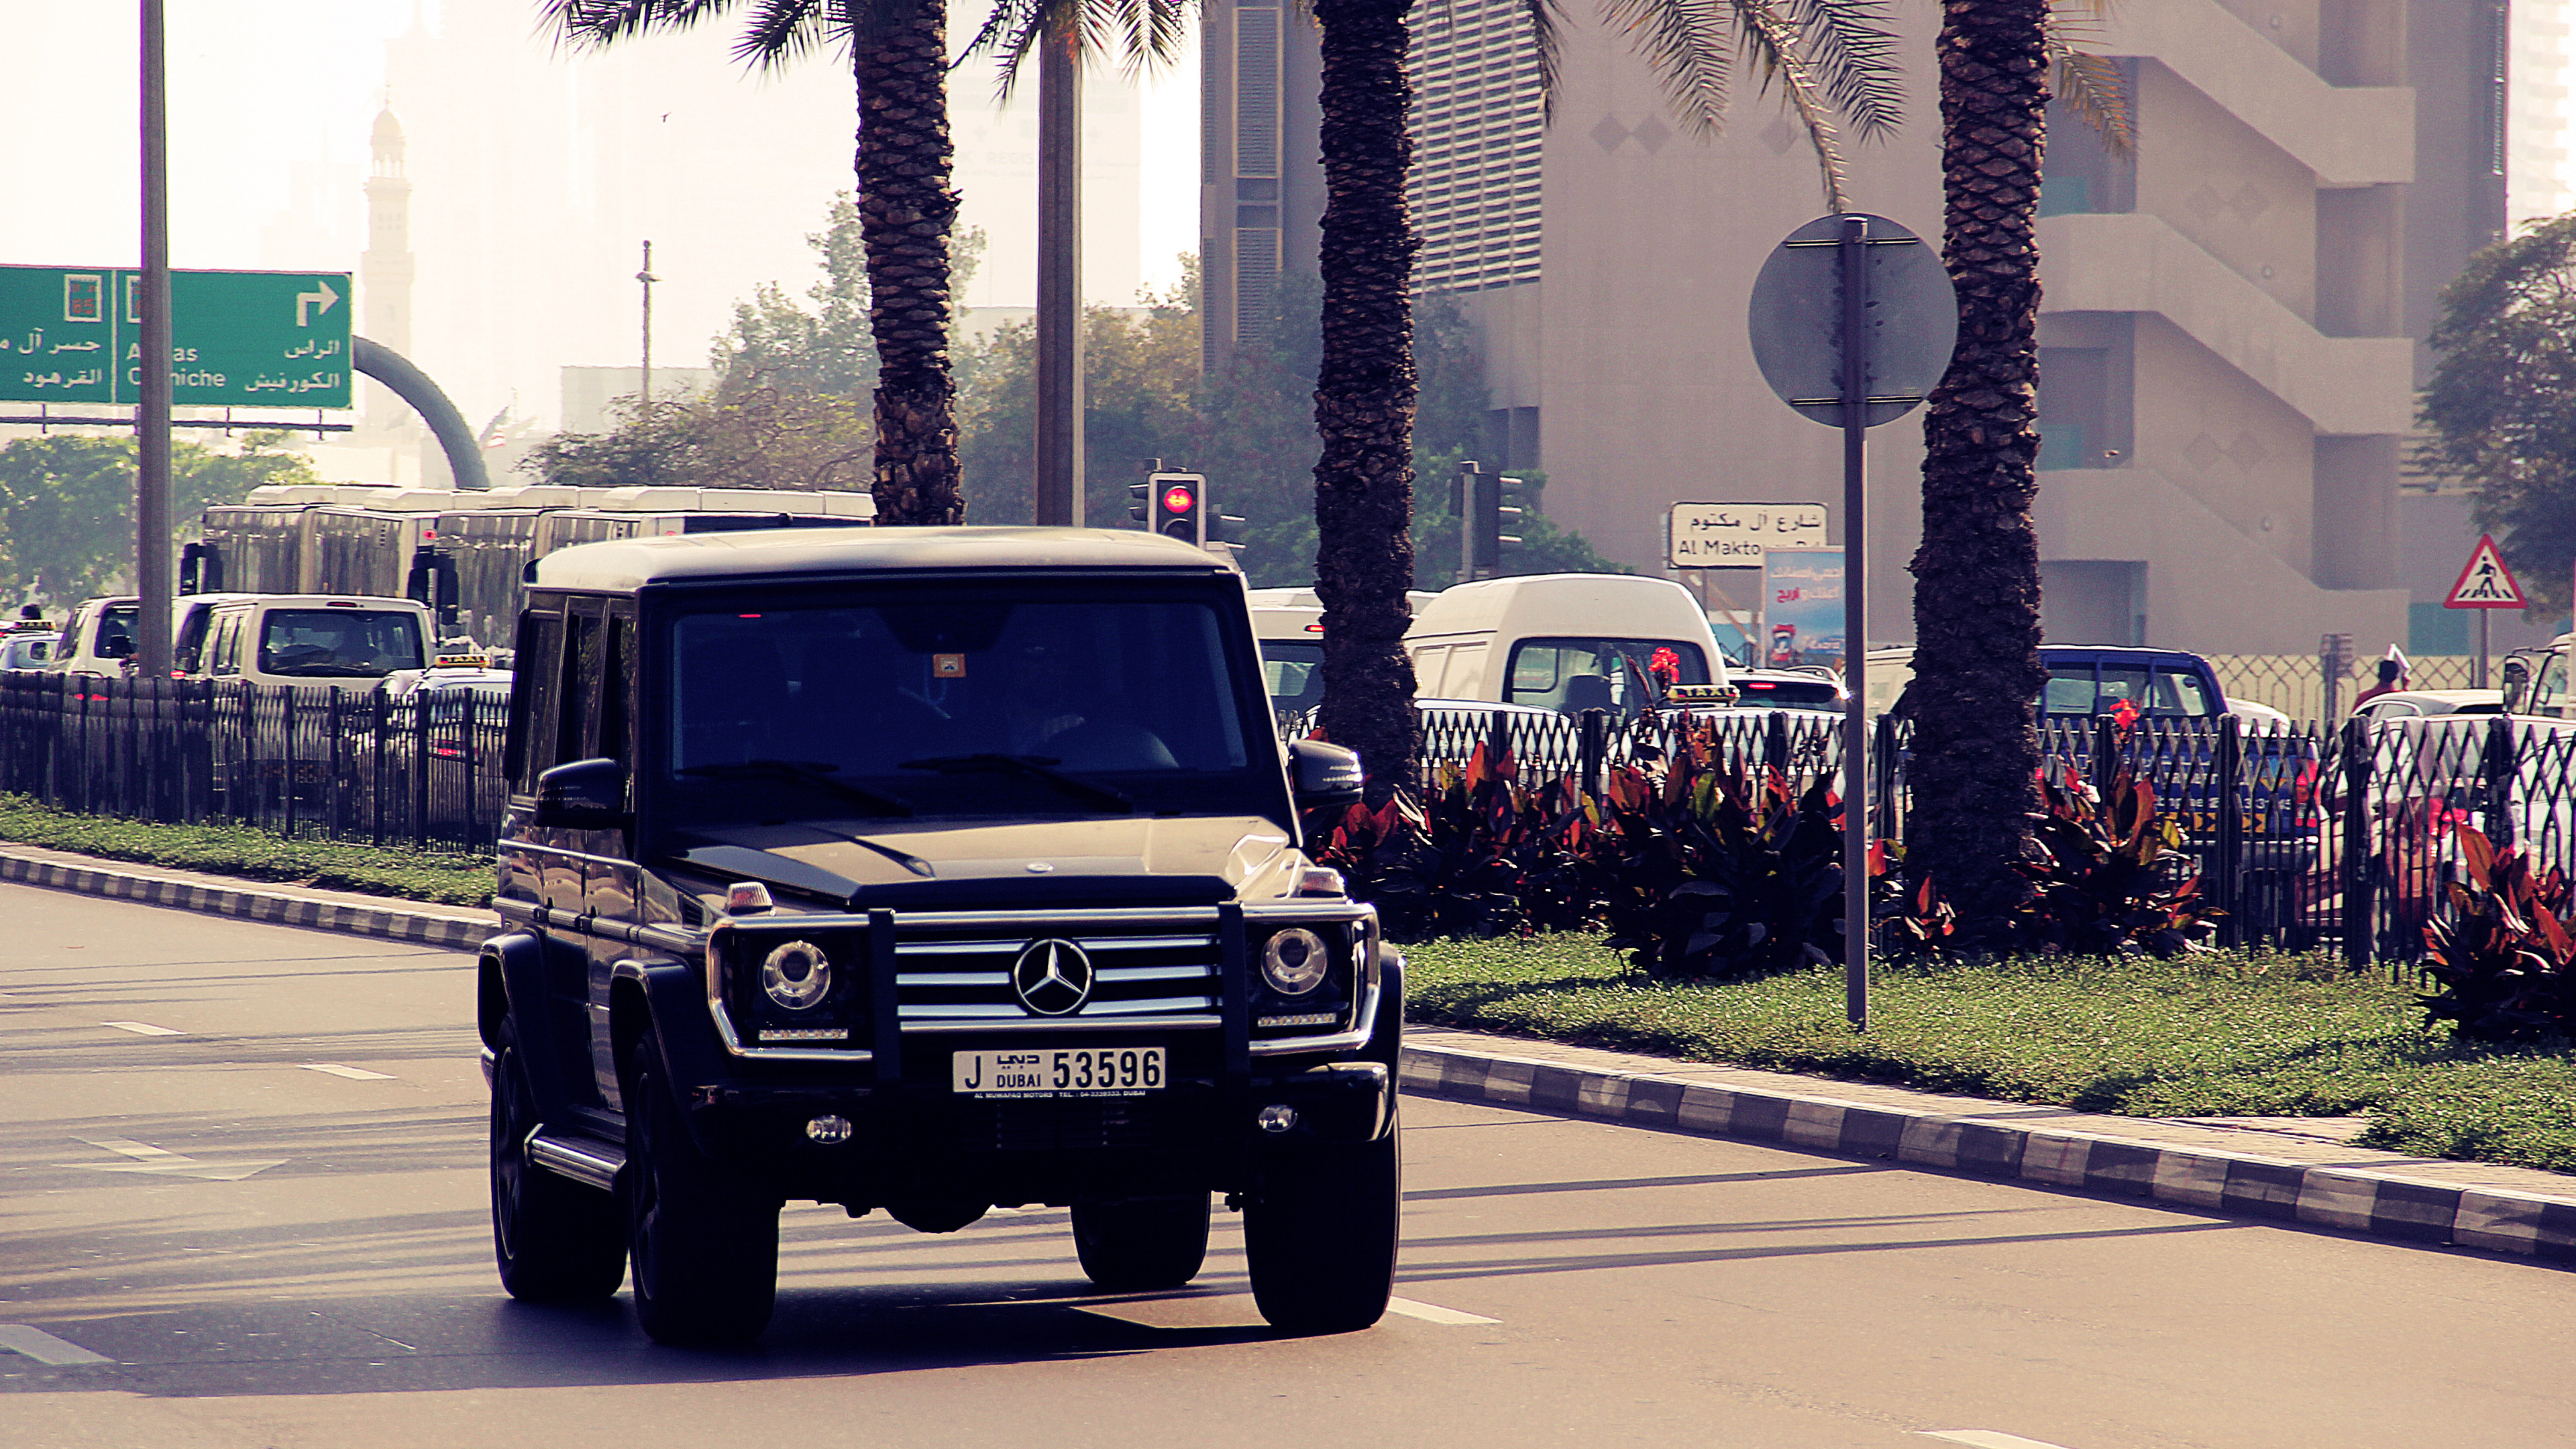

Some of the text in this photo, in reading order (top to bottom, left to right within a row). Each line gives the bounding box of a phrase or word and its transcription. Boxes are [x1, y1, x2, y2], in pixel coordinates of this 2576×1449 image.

[72, 298, 95, 314] 85
[17, 327, 44, 354] آل
[48, 341, 101, 355] جسر
[245, 372, 341, 394] الكورنيش
[1690, 510, 1821, 533] شارع آل مكتوم
[1678, 541, 1697, 555] Al
[1684, 688, 1730, 696] TAXI
[965, 1051, 1161, 1089] J DUBAI 53596
